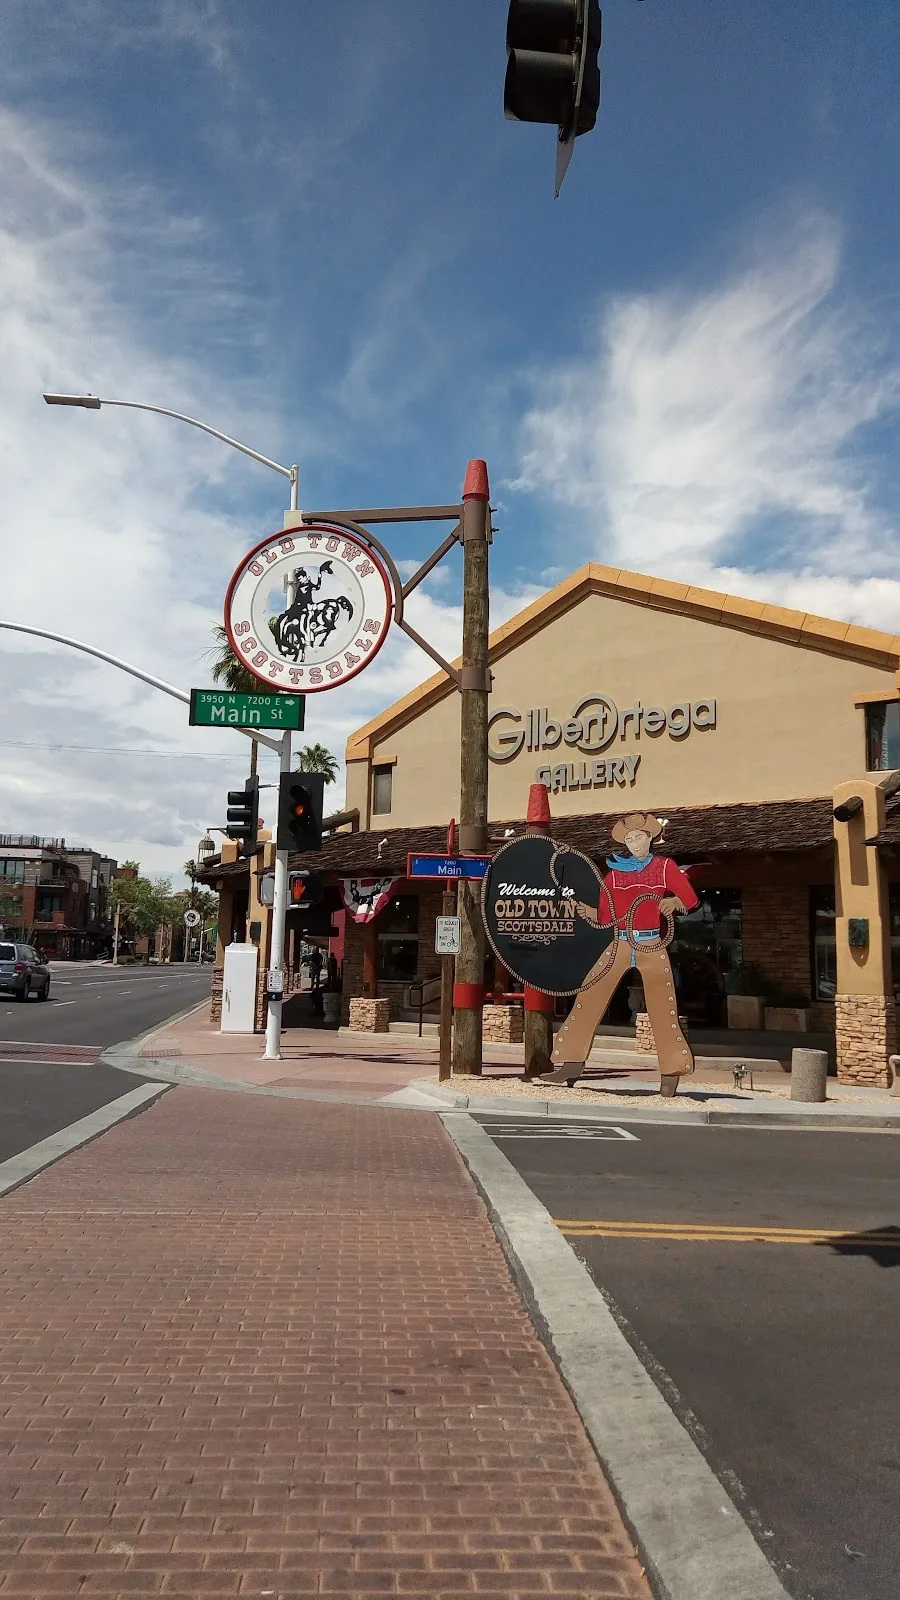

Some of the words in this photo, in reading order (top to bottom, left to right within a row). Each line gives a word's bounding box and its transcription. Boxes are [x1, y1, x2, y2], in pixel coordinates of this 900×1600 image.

[248, 537, 295, 577] OLD
[307, 532, 375, 578] TOWN
[234, 618, 381, 684] SCOTTSDALE
[200, 694, 225, 704] 3950
[228, 696, 236, 704] N
[247, 696, 271, 705] 7200
[275, 697, 281, 706] E
[210, 705, 261, 724] Main
[270, 708, 283, 720] St
[487, 704, 607, 764] Gilbert
[572, 692, 717, 756] Ortega
[534, 754, 642, 794] GALLERY
[437, 865, 462, 875] Main
[497, 882, 556, 896] Welcome
[561, 886, 575, 897] to
[494, 899, 528, 918] OLD
[529, 899, 577, 918] TOWN
[497, 920, 574, 933] SCOTTSDALE
